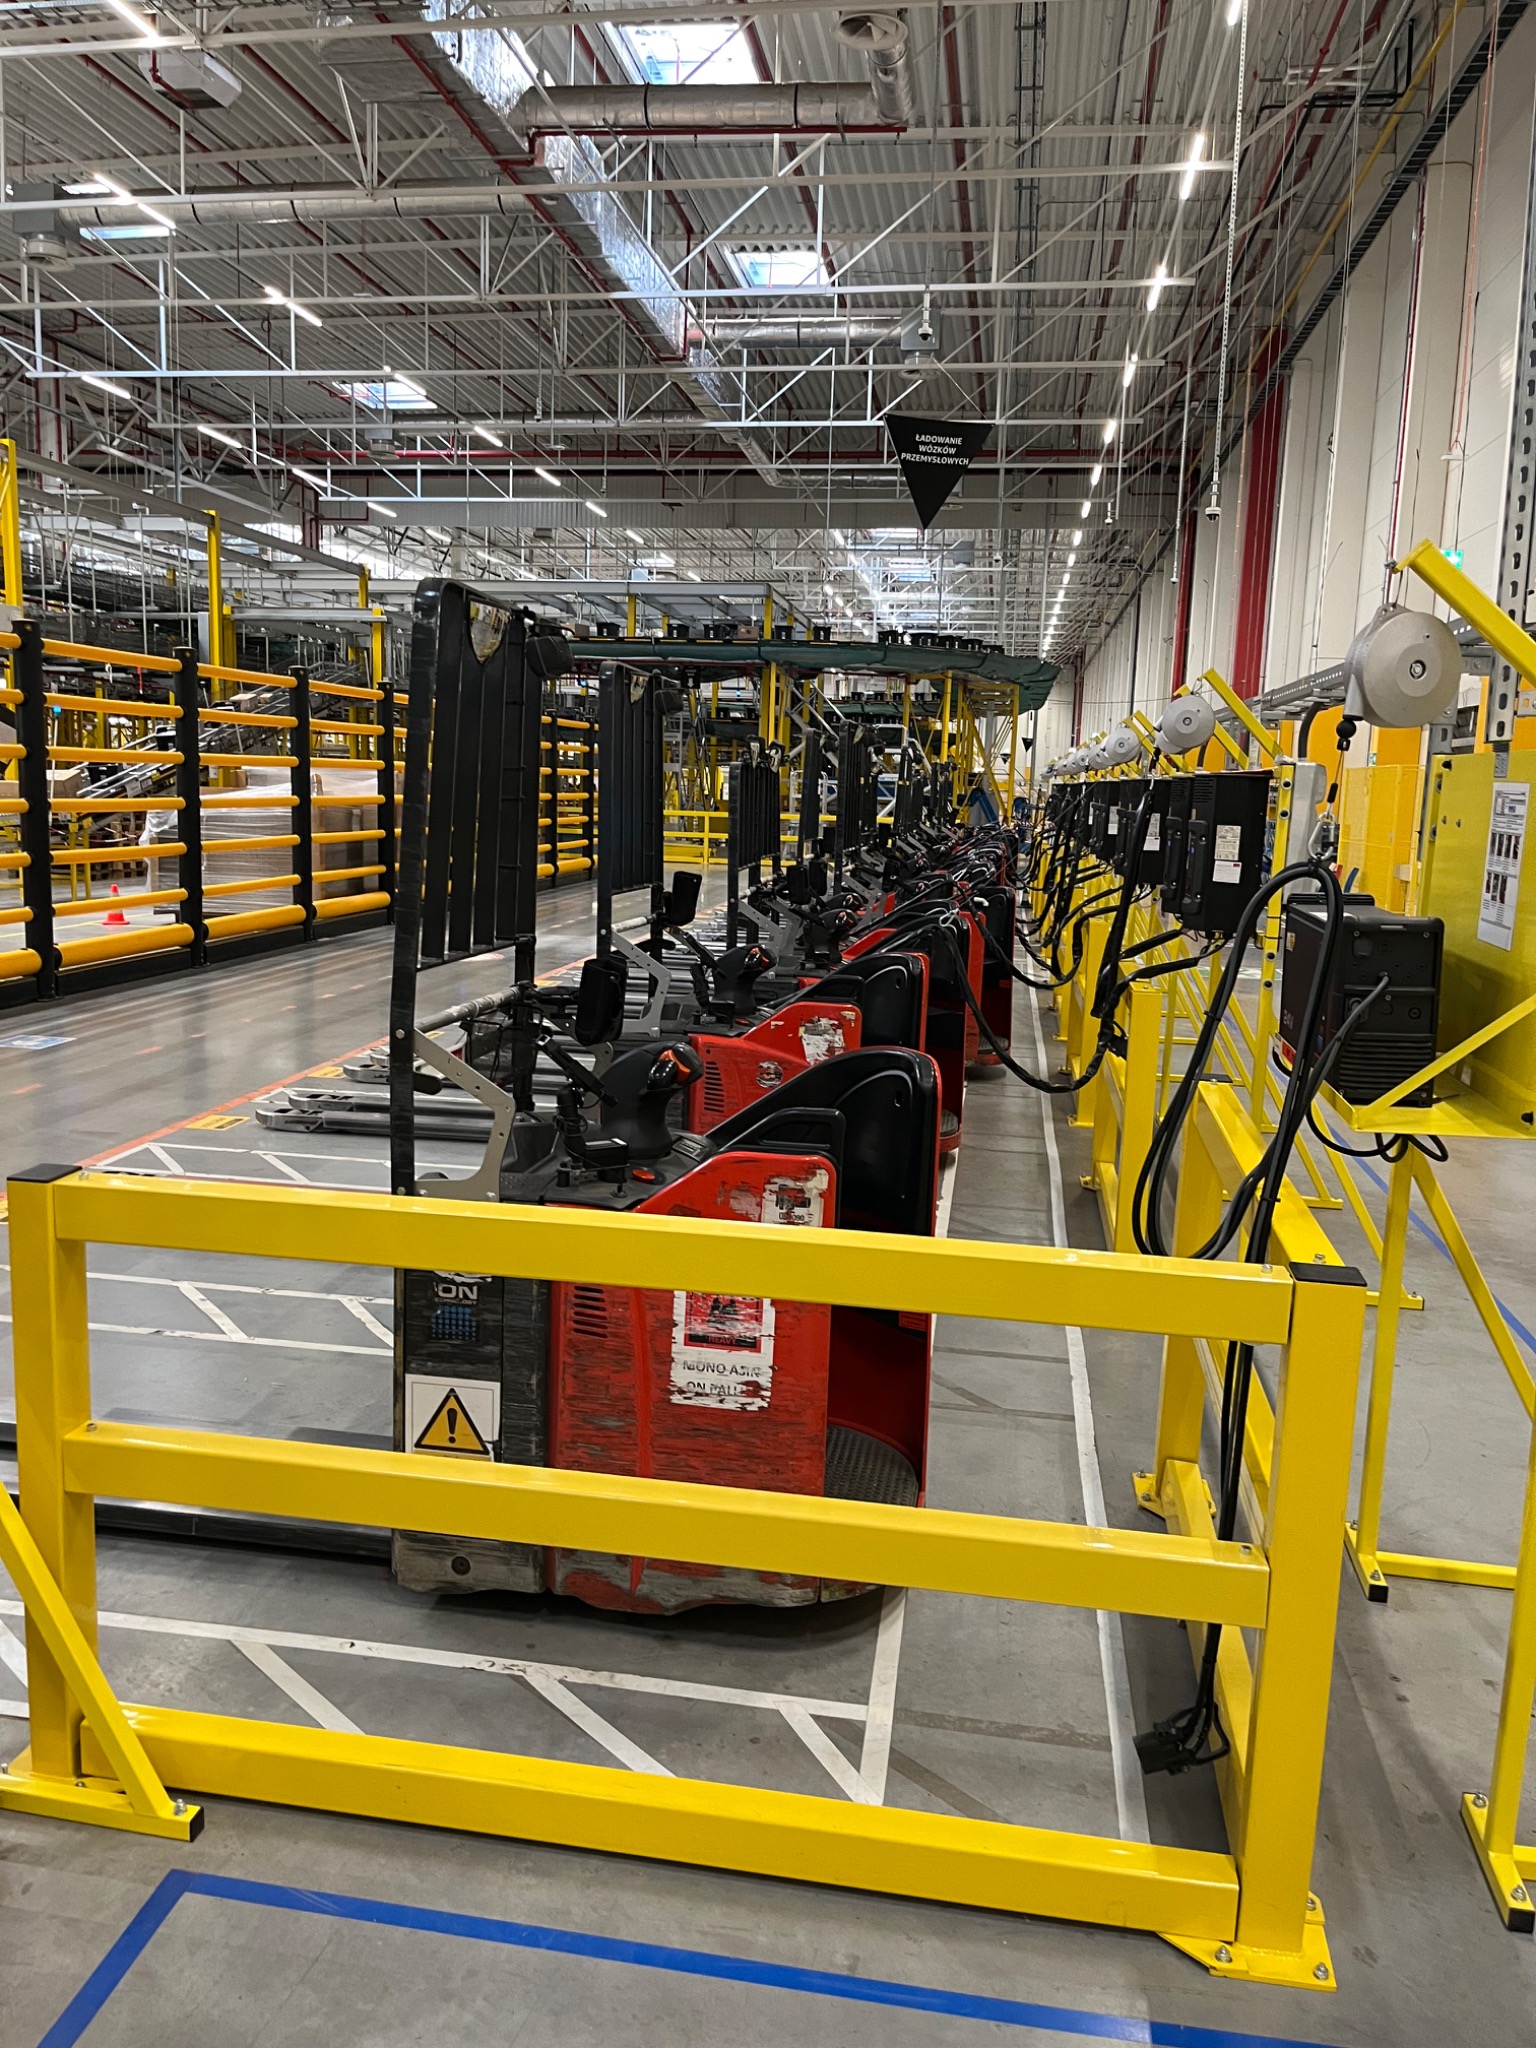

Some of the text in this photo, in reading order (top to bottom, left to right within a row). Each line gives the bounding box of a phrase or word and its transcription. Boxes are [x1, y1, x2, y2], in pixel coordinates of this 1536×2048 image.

[915, 434, 962, 445] ŁADOWANIE
[918, 444, 957, 455] WÓZKÓW
[901, 453, 969, 465] PRZEMYSŁOWYCH
